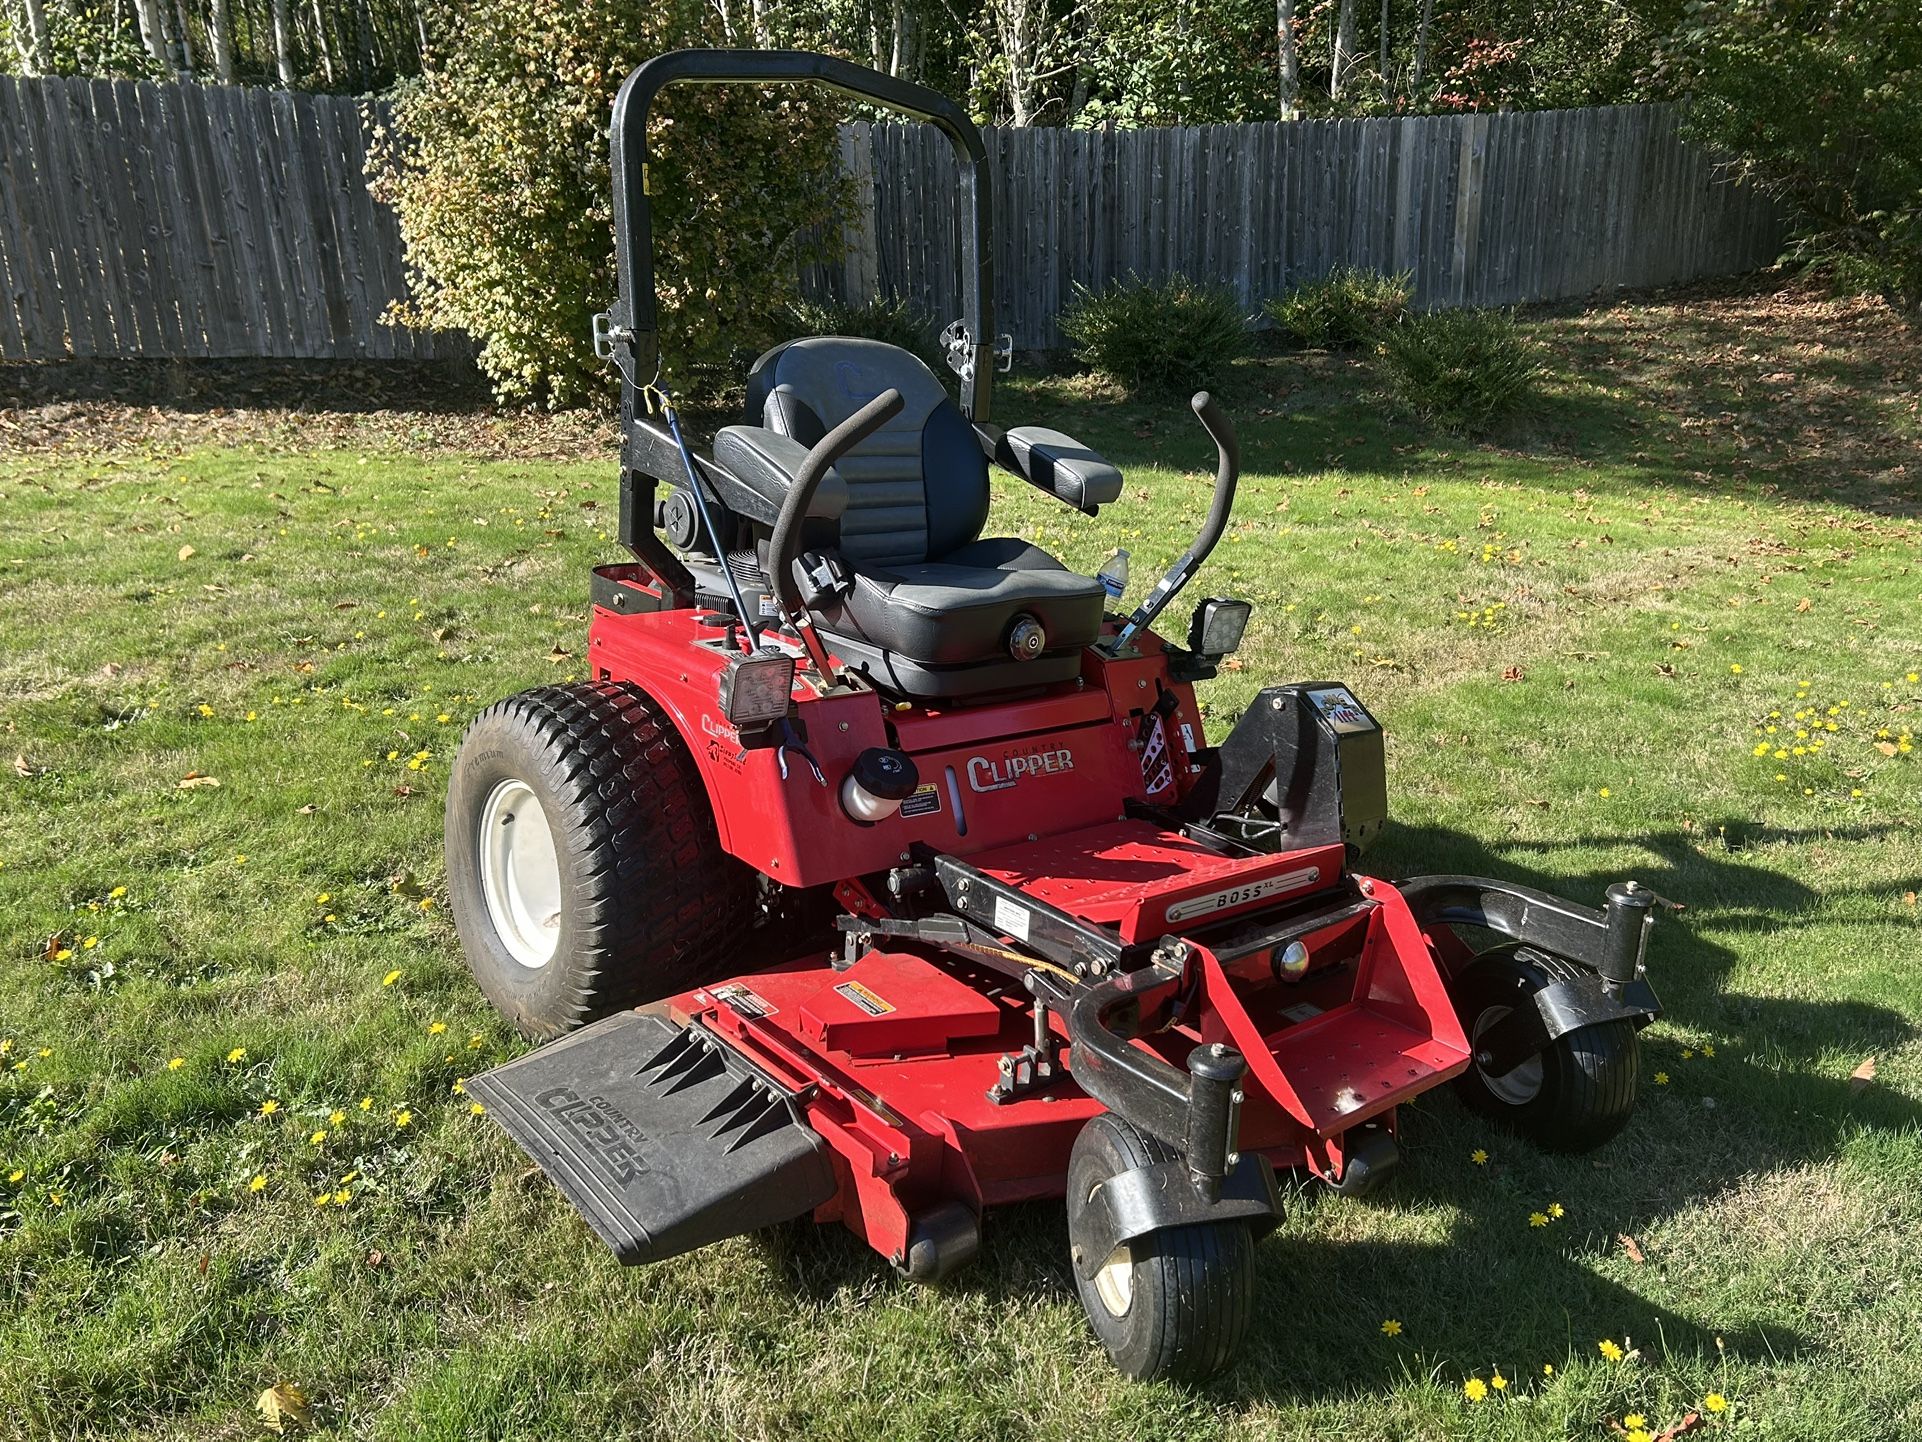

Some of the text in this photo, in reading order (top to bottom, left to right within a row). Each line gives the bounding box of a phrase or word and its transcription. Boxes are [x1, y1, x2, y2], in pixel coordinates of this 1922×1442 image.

[463, 750, 504, 778] Premium
[1002, 742, 1065, 759] COUNTRY
[966, 749, 1075, 793] CLIPPER
[1216, 885, 1262, 908] BOSS
[588, 1096, 651, 1143] COUNTRY
[534, 1087, 652, 1193] CLIPPER
